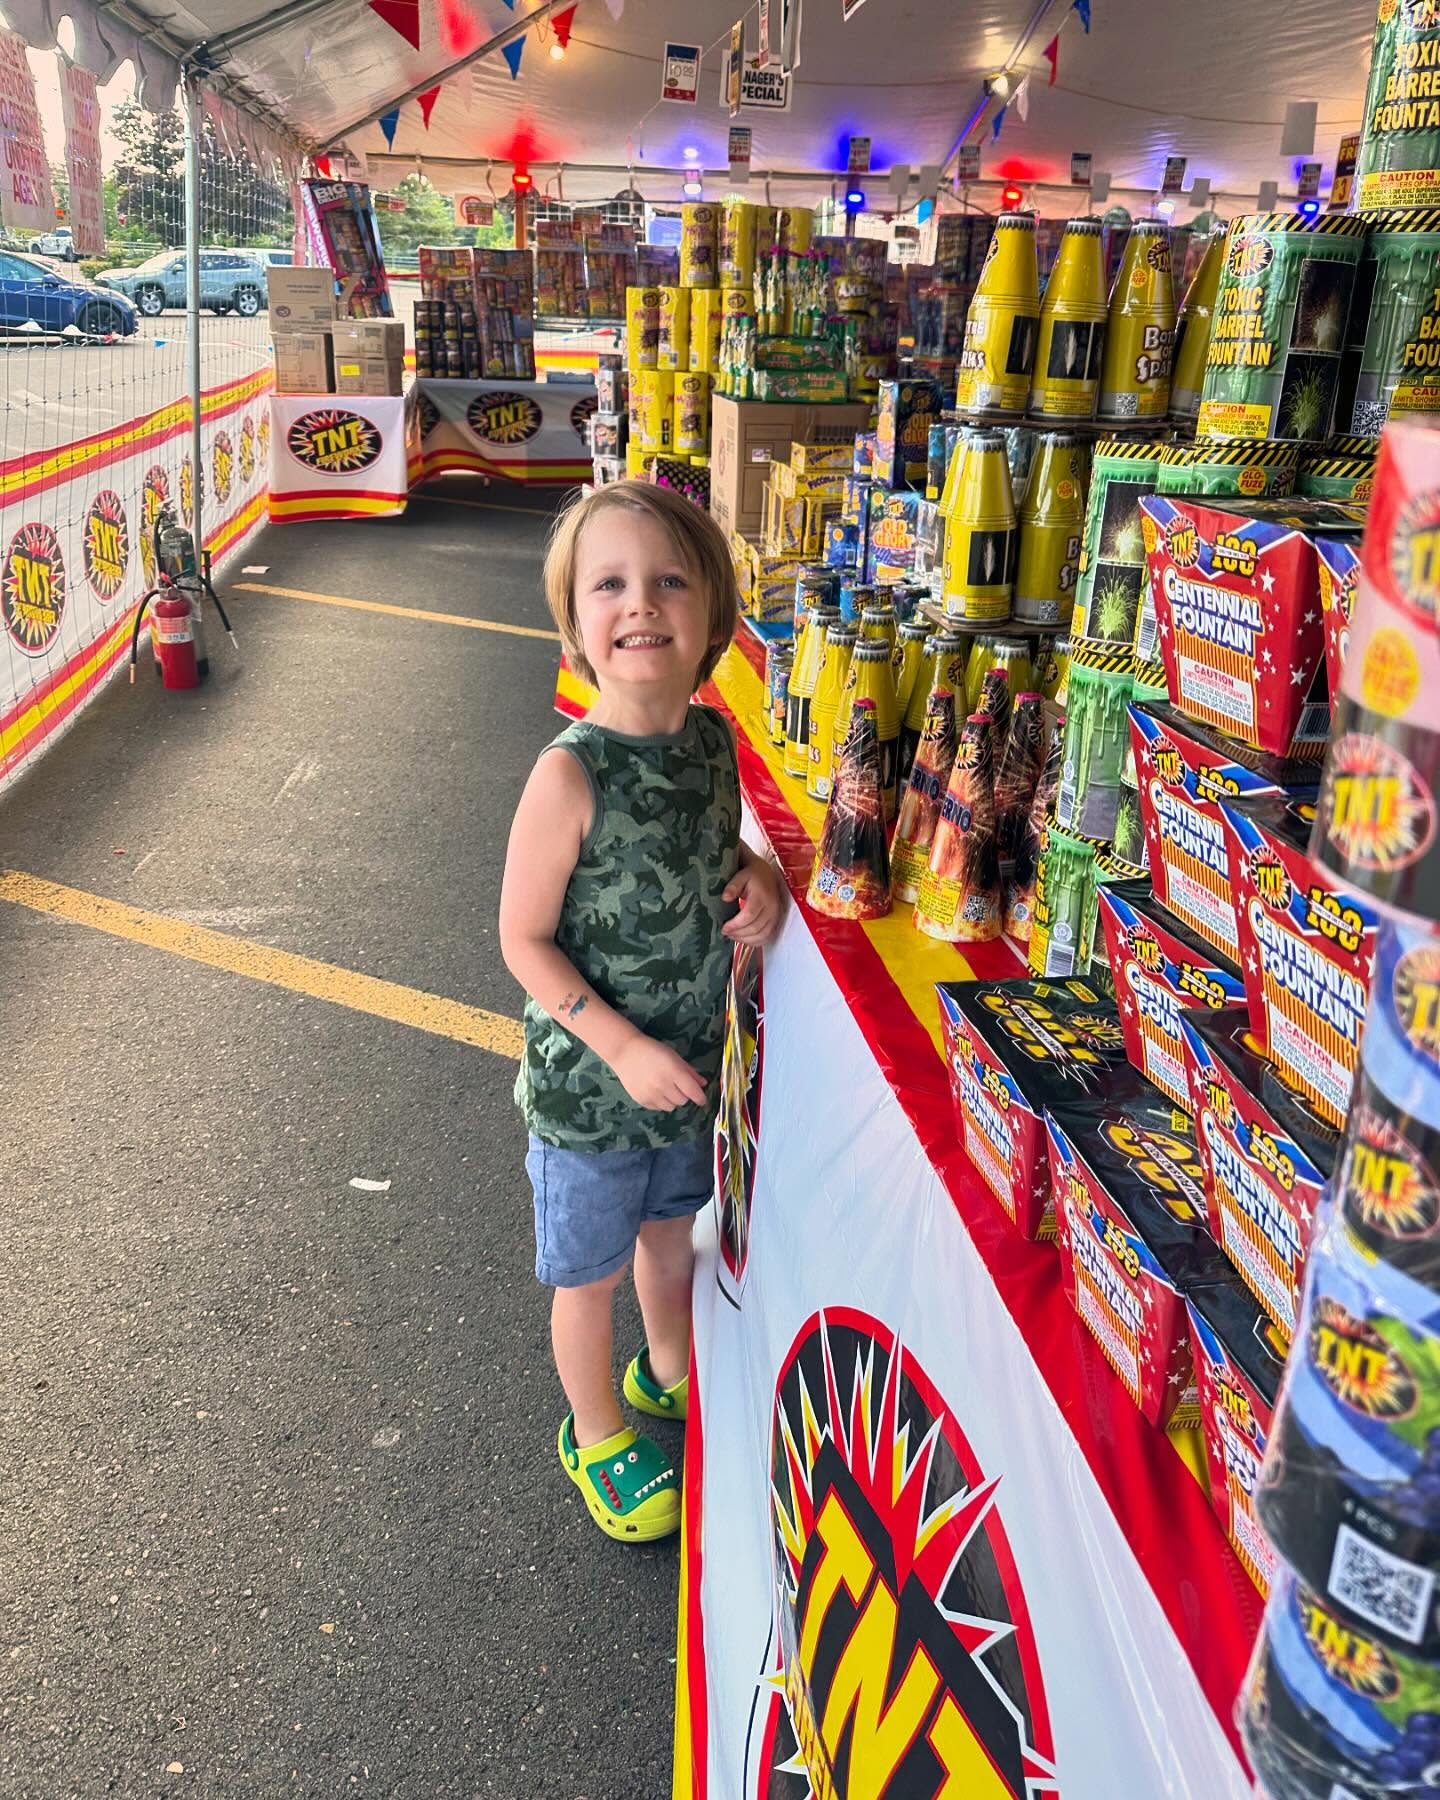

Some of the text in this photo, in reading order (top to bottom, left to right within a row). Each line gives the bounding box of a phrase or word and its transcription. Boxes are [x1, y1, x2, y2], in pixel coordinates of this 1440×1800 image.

[1394, 40, 1440, 74] TOXI
[744, 70, 784, 87] NAGER'S
[742, 87, 783, 101] PECIAL
[313, 183, 347, 199] BIG
[1380, 171, 1435, 183] CAUTION
[1223, 286, 1264, 312] TOXIC
[1215, 314, 1264, 339] BARREL
[1207, 342, 1272, 366] FOUNTAIN
[486, 403, 526, 431] TNT
[312, 421, 362, 458] TNT
[1240, 480, 1263, 489] FUZE
[1241, 471, 1264, 480] GLO-
[873, 531, 914, 549] GLORY
[882, 518, 907, 533] OLD
[1172, 528, 1194, 557] TNT
[1211, 533, 1258, 577] 100
[1164, 567, 1263, 627] CENTENNIAL
[1173, 604, 1254, 656] FOUNTAIN
[1194, 664, 1234, 688] CAUTION
[1156, 751, 1179, 775] TNT
[1333, 776, 1396, 827] TNT
[1181, 874, 1220, 907] CAUTION
[1257, 865, 1283, 892] TNT
[1306, 885, 1364, 952] 100
[1134, 939, 1157, 960] TNT
[1249, 899, 1367, 1016] CENTENNIAL
[1126, 962, 1185, 1014] CENTE
[1263, 945, 1358, 1045] FOUNTAIN
[1285, 1021, 1332, 1070] CAUTION
[1208, 1084, 1230, 1110] TNT
[1201, 1110, 1304, 1259] CENTENNIAL
[1351, 1144, 1409, 1199] TNT
[1069, 1178, 1089, 1206] TNT
[1214, 1156, 1295, 1270] FOUNTAIN
[1316, 1324, 1388, 1385] TNT
[1221, 1382, 1248, 1418] TNT
[1307, 1613, 1372, 1672] TNT
